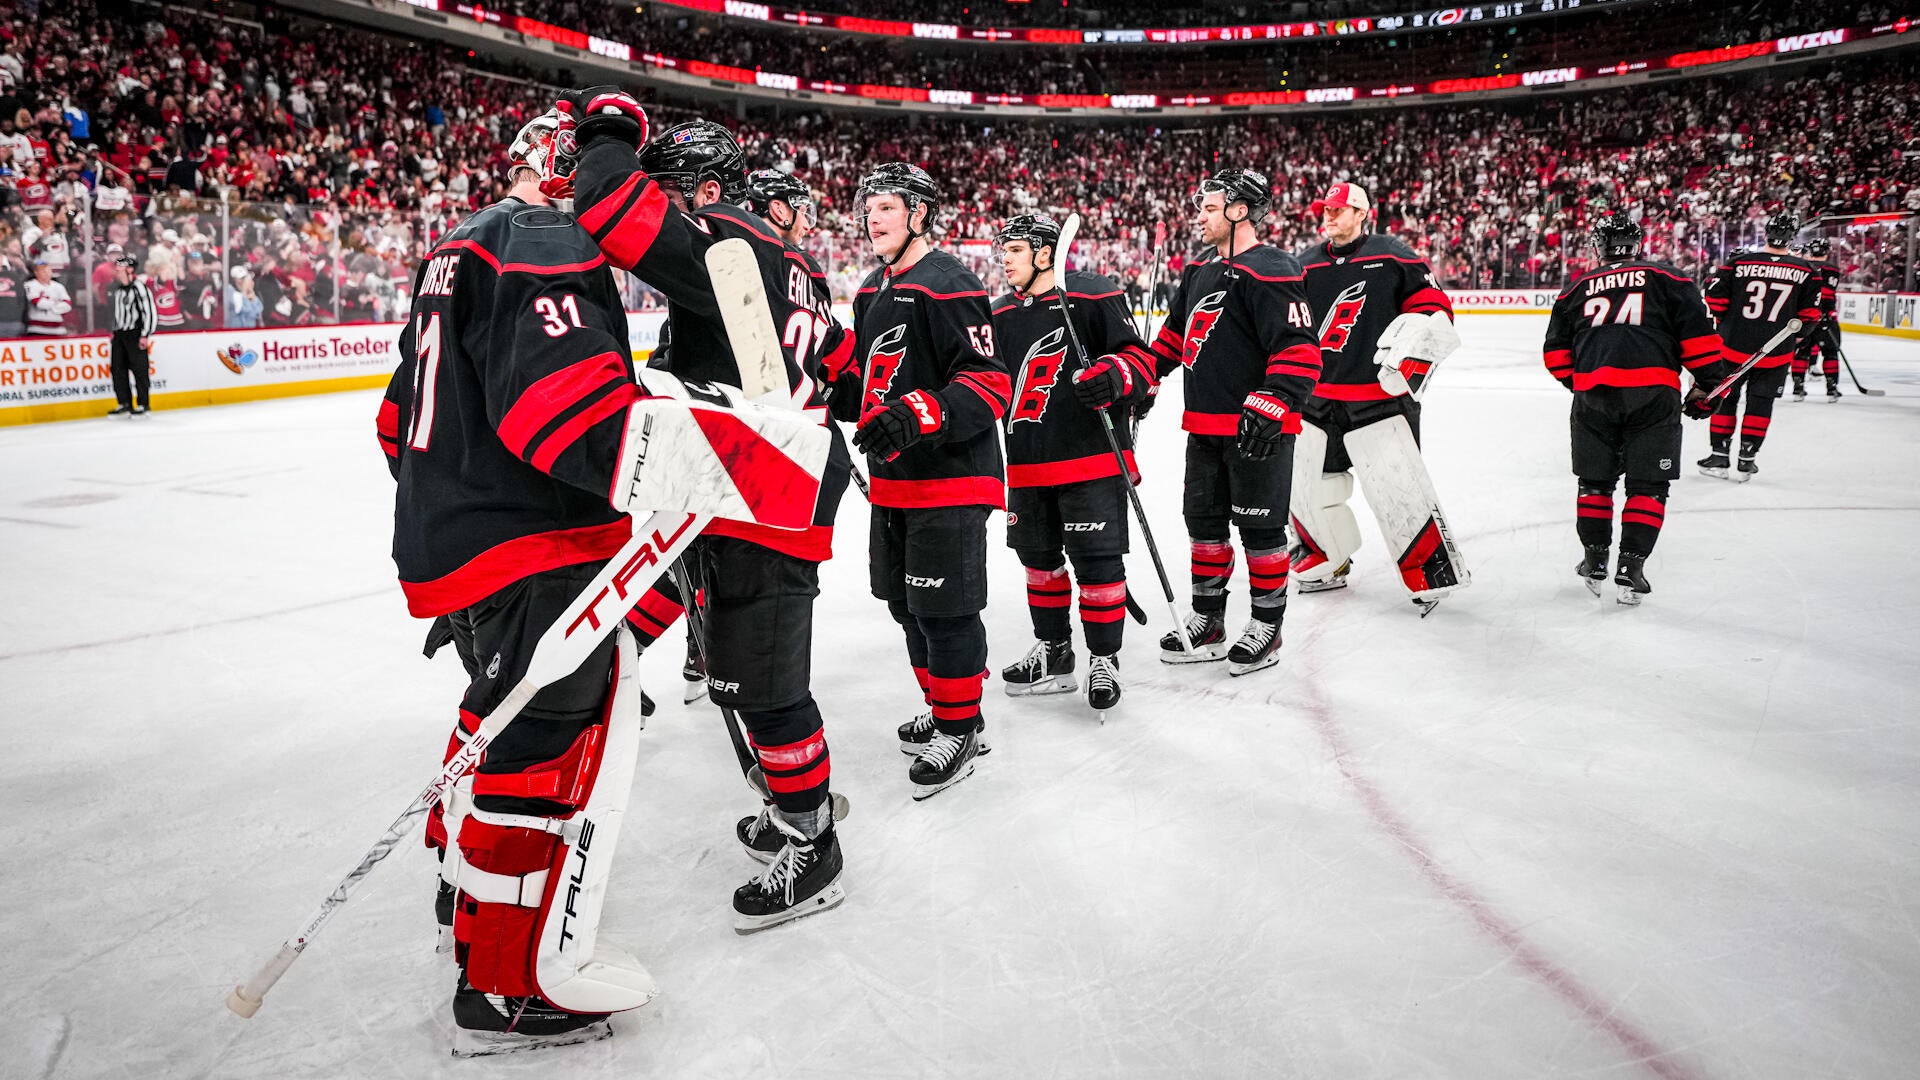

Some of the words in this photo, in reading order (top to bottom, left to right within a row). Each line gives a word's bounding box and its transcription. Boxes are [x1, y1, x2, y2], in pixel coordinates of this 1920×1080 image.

[724, 0, 769, 20] WIN
[912, 23, 958, 39] WIN
[1777, 28, 1844, 52] WIN
[588, 35, 631, 61] WIN
[755, 71, 798, 90] WIN
[1522, 67, 1577, 86] WIN
[928, 89, 973, 104] WIN
[1110, 94, 1156, 108] WIN
[1305, 87, 1354, 102] WIN
[1615, 245, 1627, 255] 24
[1585, 270, 1646, 297] JARVIS
[1735, 264, 1810, 284] SVECHNIKOV
[1451, 295, 1529, 305] HONDA
[1584, 292, 1644, 328] 24
[1742, 280, 1794, 322] 37
[534, 294, 586, 338] 31
[1288, 302, 1312, 328] 48
[44, 341, 155, 362] SURGY
[263, 338, 328, 361] Harris
[329, 336, 392, 356] Teeter
[966, 324, 995, 358] 53
[0, 360, 156, 387] RTHODONS
[27, 387, 80, 400] SURGEON
[627, 412, 654, 507] TRUE
[1064, 521, 1107, 532] CCM
[1432, 504, 1456, 553] TRUE
[565, 512, 697, 640] TRU
[905, 573, 946, 588] CCM
[423, 734, 488, 805] SMOKE
[559, 817, 596, 954] TRUE
